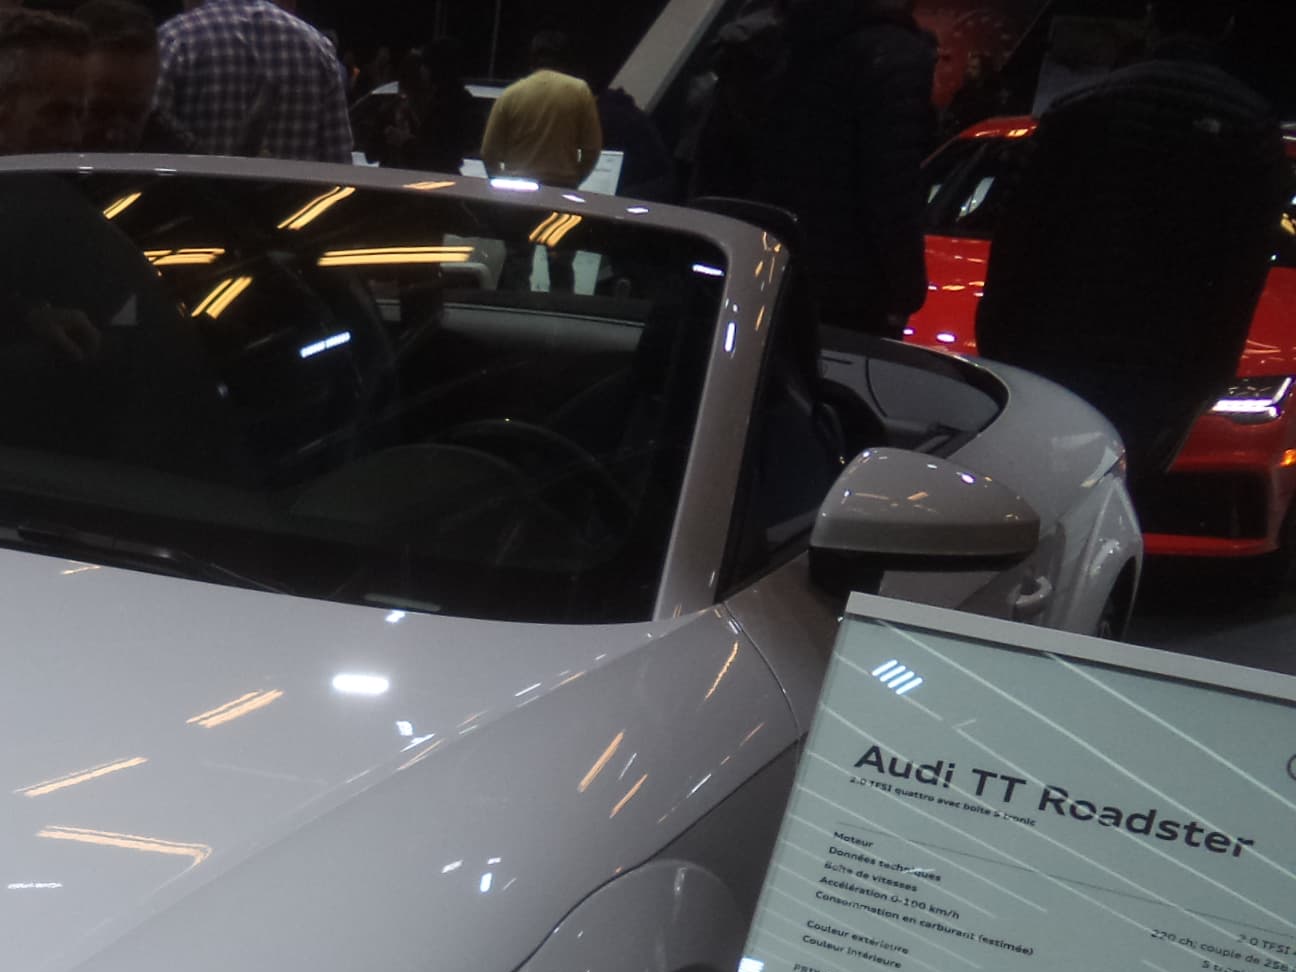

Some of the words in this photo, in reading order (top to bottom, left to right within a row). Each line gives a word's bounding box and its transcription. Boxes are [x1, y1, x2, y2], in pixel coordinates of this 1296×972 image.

[854, 742, 956, 789] Audi
[965, 768, 1027, 806] TT
[1036, 784, 1257, 860] Roadster
